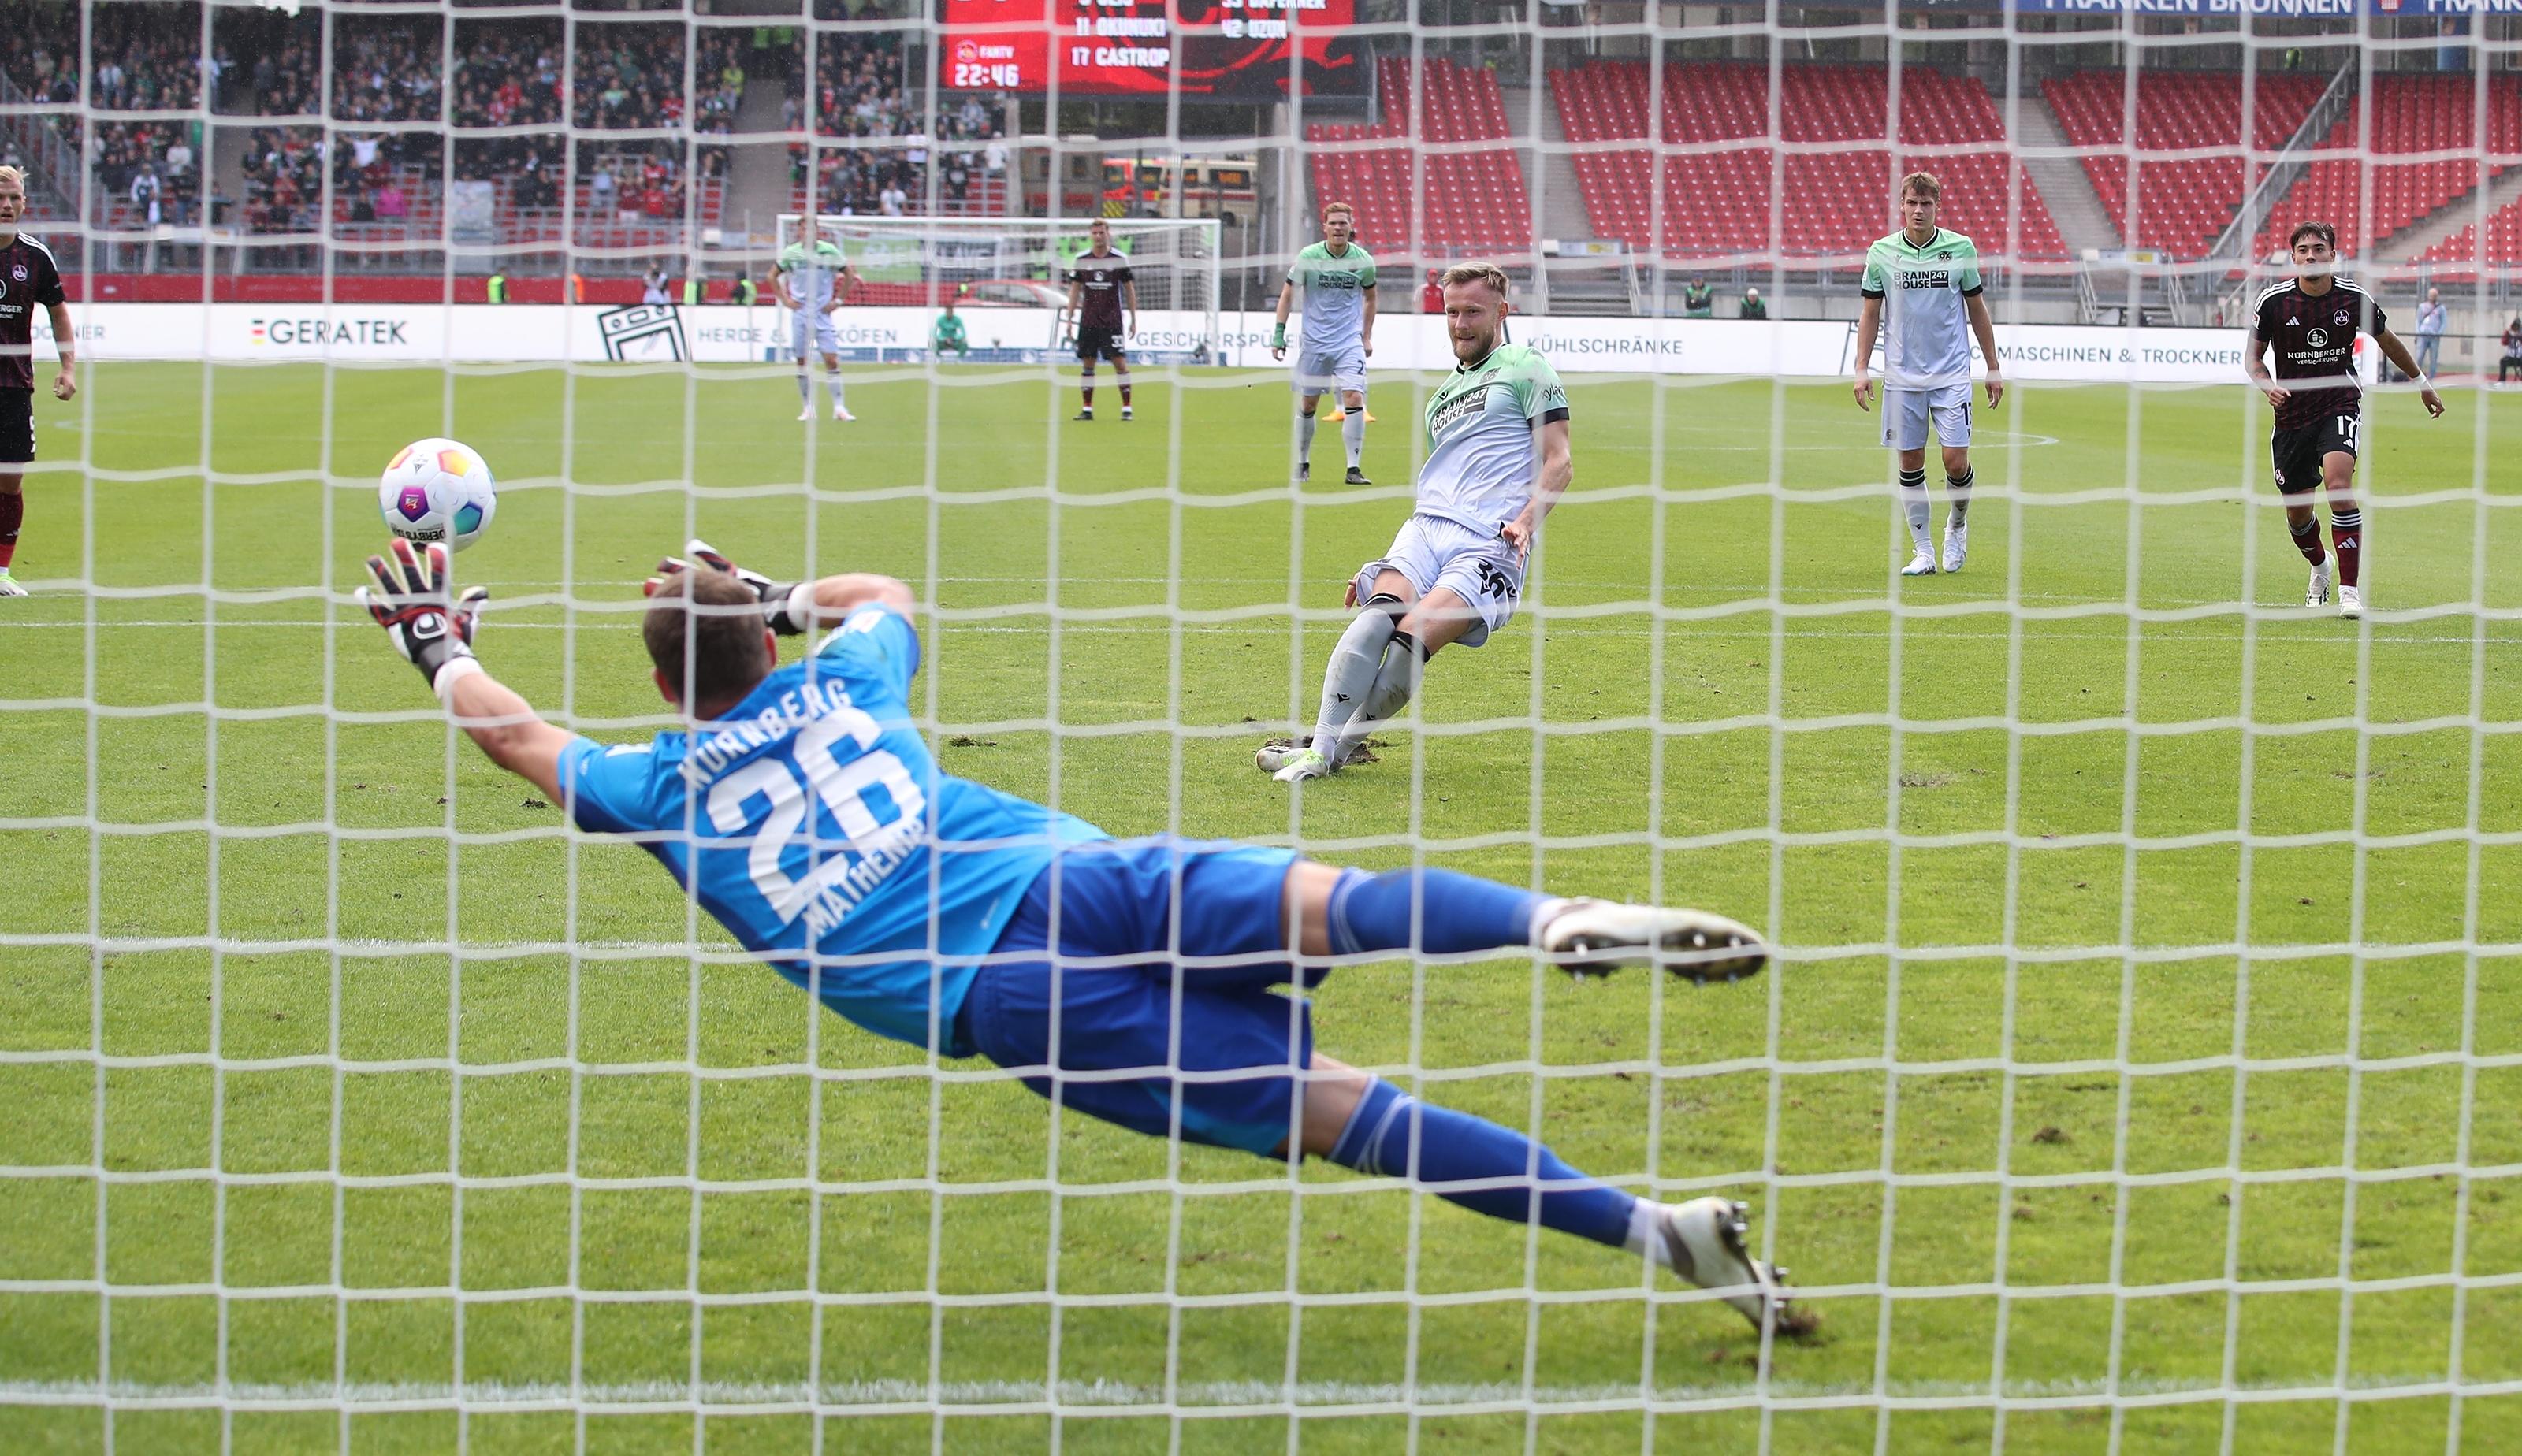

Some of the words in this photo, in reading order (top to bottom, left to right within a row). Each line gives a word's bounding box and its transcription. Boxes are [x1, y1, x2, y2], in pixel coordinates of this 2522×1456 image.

[1075, 17, 1091, 36] 11
[1222, 19, 1243, 38] 42
[1072, 46, 1090, 66] 17
[1095, 46, 1170, 67] CASTROP
[954, 63, 1019, 87] 22:46
[1894, 270, 1929, 280] BRAIN
[1931, 271, 1947, 280] 247
[1894, 280, 1930, 289] HOUSE
[270, 320, 407, 344] GERATEK
[699, 328, 762, 343] HERDE
[836, 324, 897, 343] KÖFEN
[1527, 334, 1683, 355] KÜHLSCHRÄNKE
[2142, 348, 2241, 365] TROCKNER
[1466, 388, 1488, 403] 247
[1434, 407, 1465, 436] HOUSE
[706, 707, 926, 926] 26
